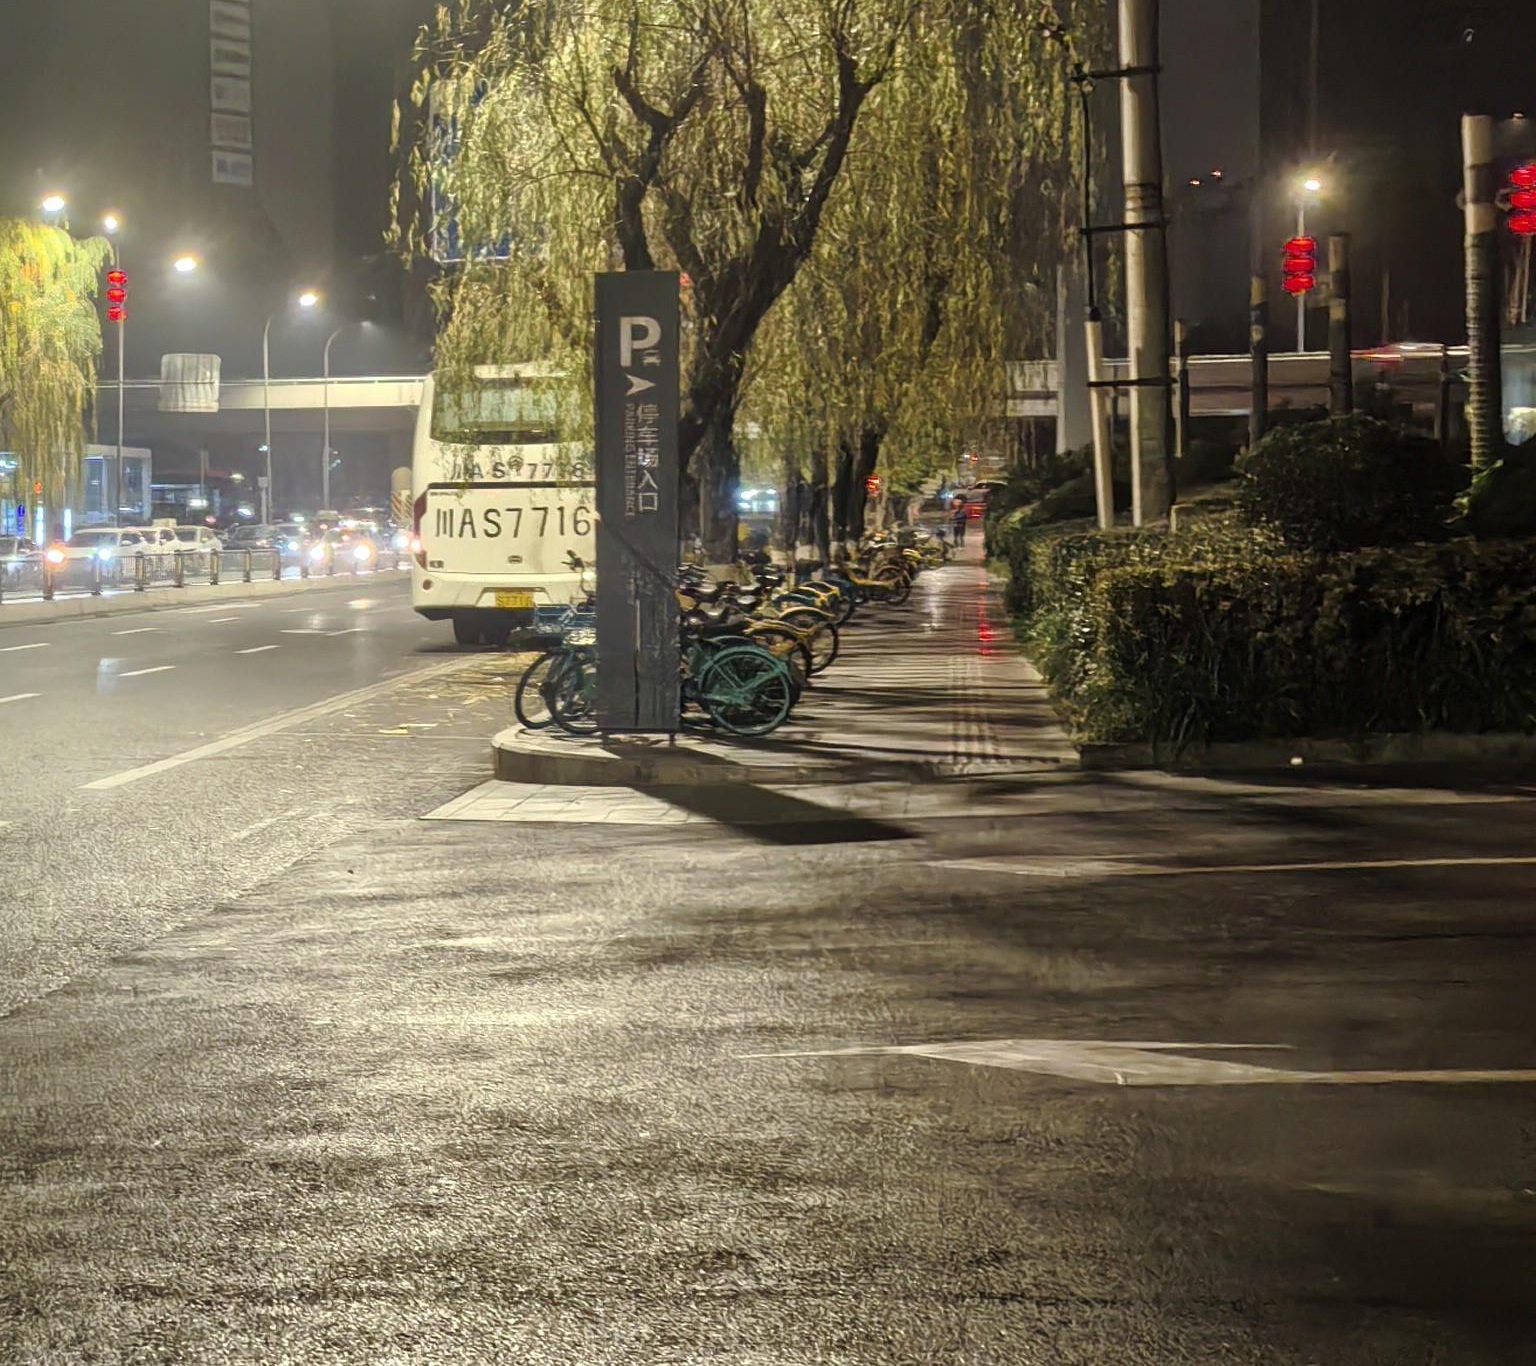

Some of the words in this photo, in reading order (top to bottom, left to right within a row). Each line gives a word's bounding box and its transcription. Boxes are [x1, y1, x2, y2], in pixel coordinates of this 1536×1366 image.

[620, 316, 661, 367] P
[637, 403, 659, 512] 停车场入口
[435, 506, 592, 539] 川AS7716
